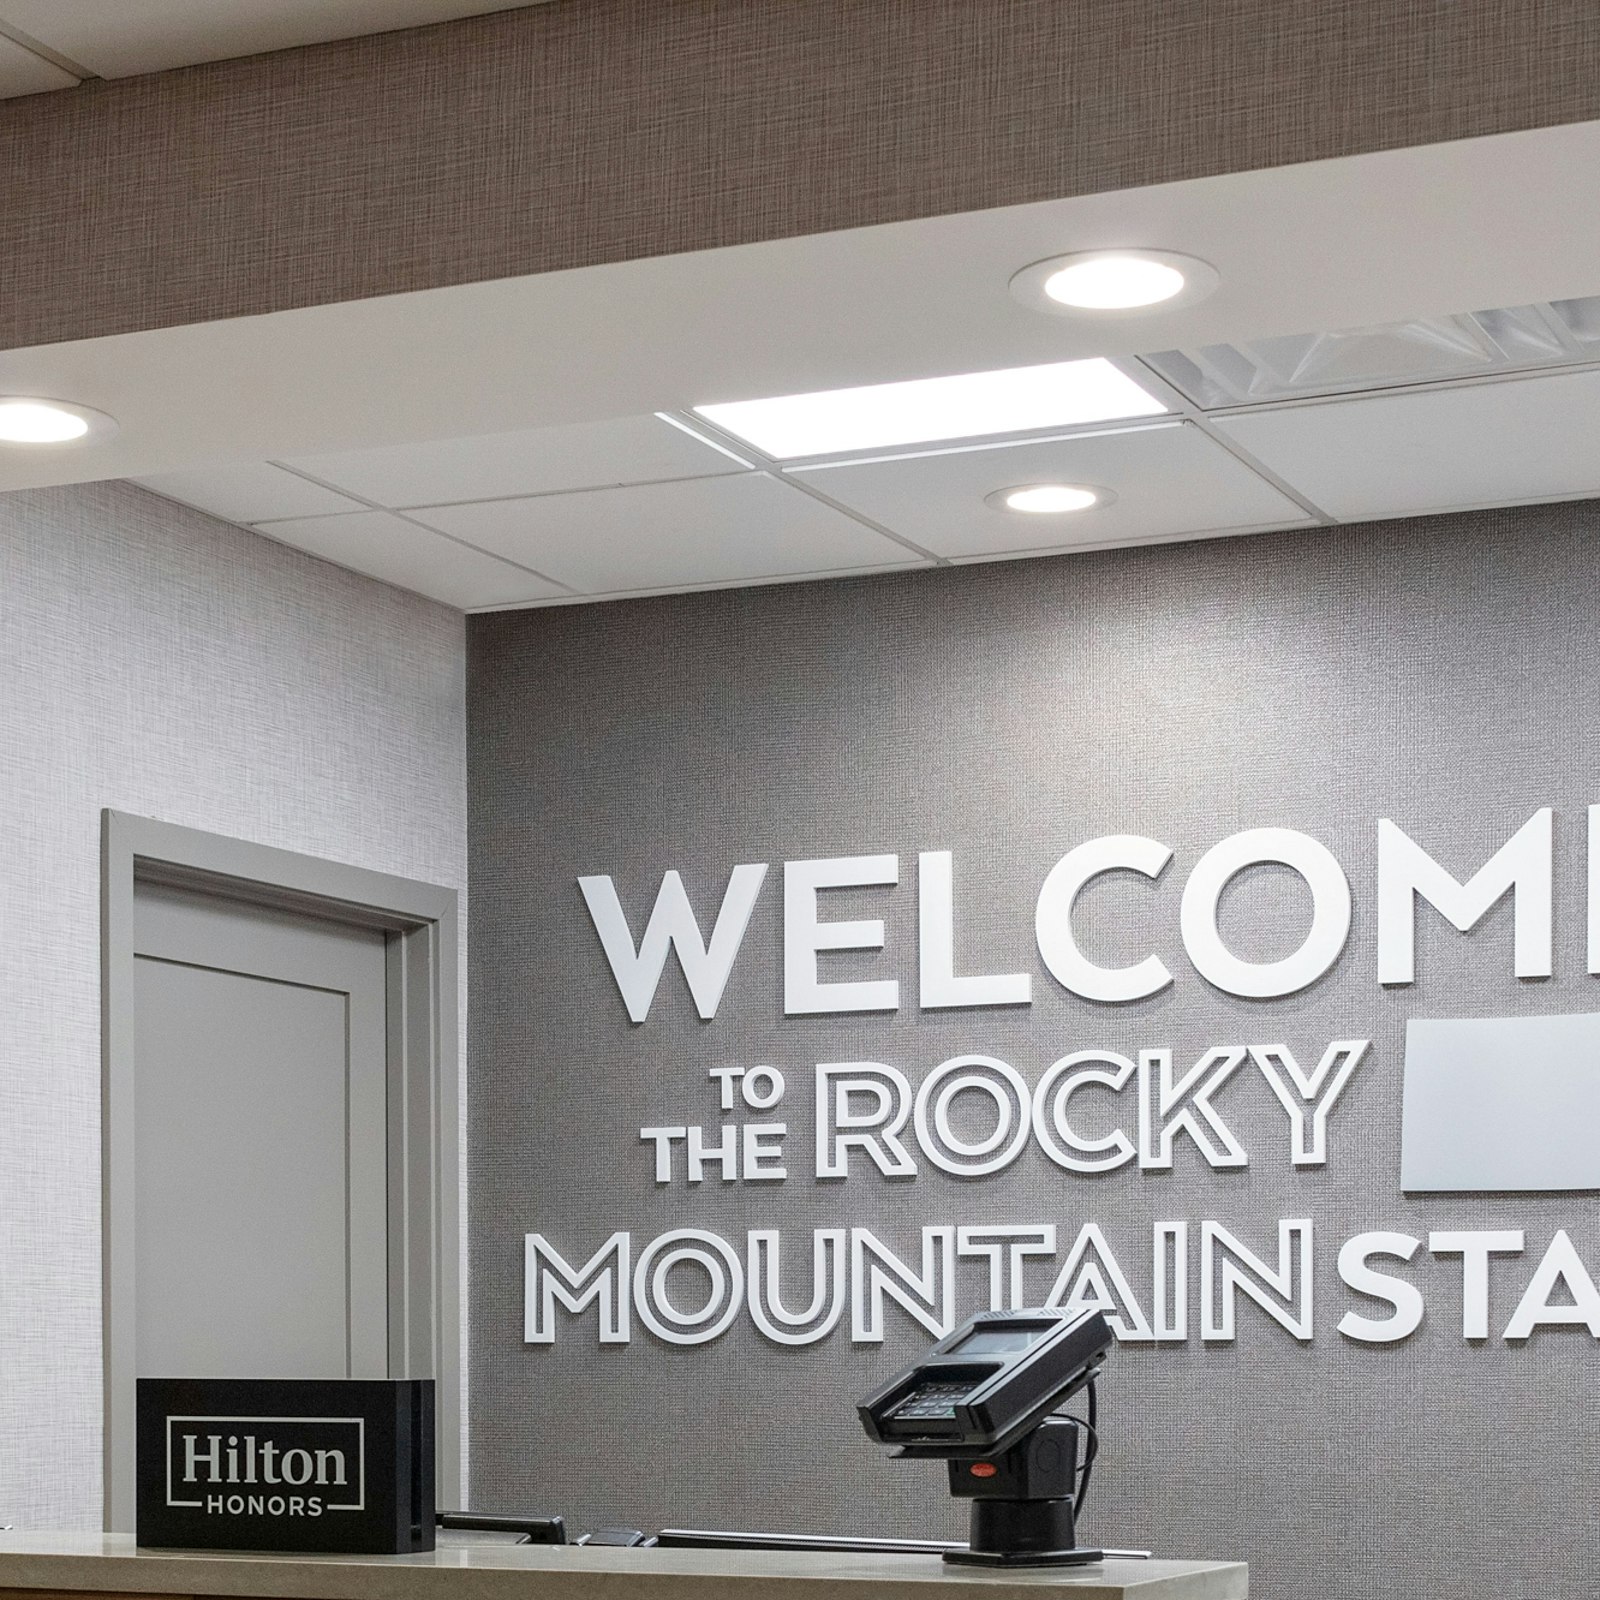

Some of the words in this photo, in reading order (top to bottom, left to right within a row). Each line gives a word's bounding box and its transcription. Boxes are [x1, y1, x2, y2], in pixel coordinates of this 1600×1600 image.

[640, 1123, 788, 1183] THE
[815, 1039, 1373, 1180] ROCKY
[710, 1064, 783, 1110] TO
[523, 1217, 1317, 1347] MOUNTAIN
[182, 1434, 348, 1486] Hilton
[207, 1494, 323, 1517] HONORS
